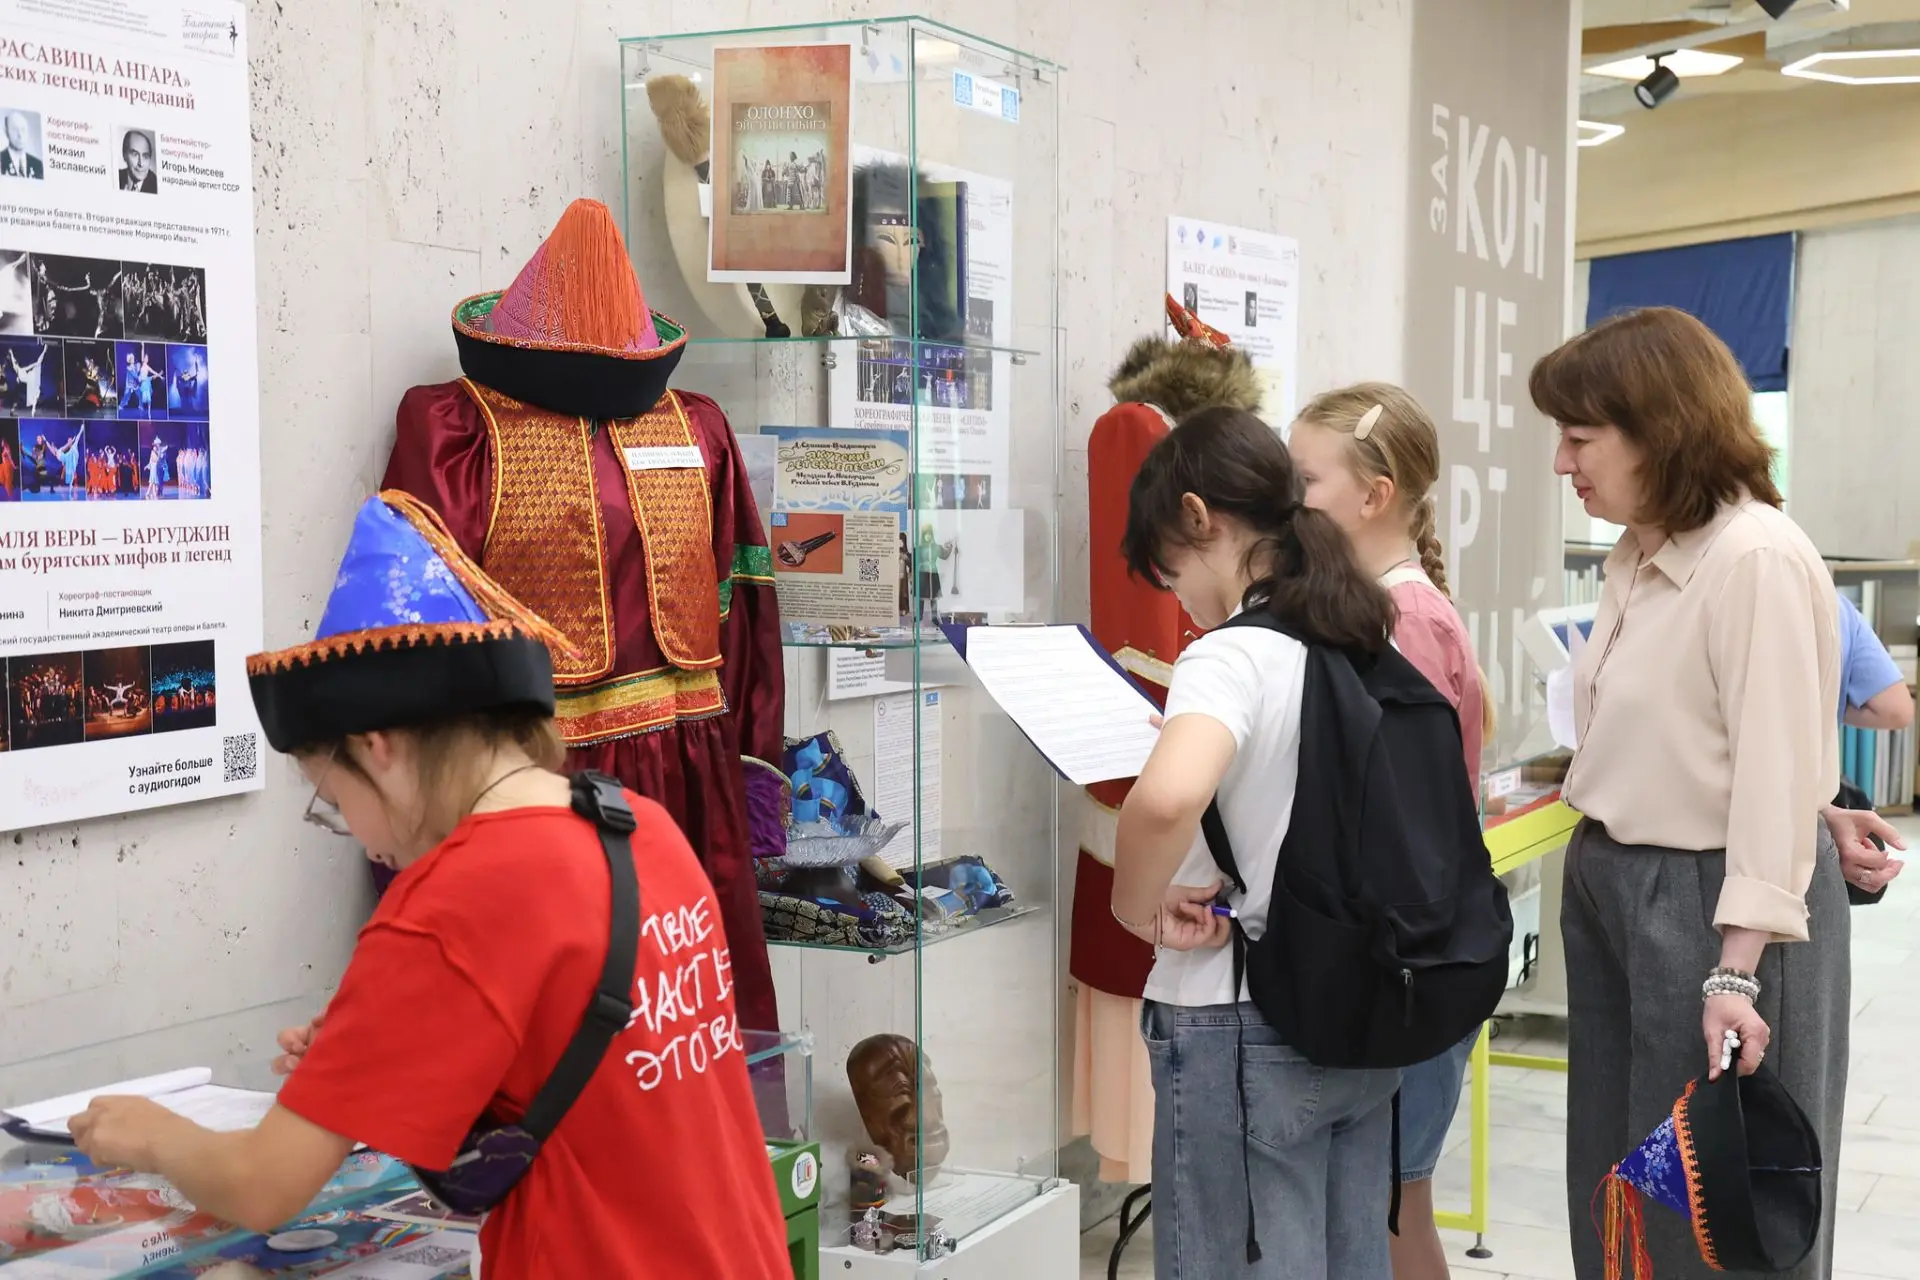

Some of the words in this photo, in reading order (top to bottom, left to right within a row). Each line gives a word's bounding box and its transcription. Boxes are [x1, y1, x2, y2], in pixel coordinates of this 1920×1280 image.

[113, 59, 191, 88] АНГАРА»
[42, 72, 99, 95] легенд
[104, 84, 113, 96] и
[119, 85, 195, 111] преданий
[48, 144, 85, 158] Михаил
[49, 158, 106, 175] Заславский
[162, 160, 188, 174] Игорь
[188, 164, 224, 178] Моисеев
[1430, 103, 1449, 235] ЗАЛ
[162, 176, 197, 187] народный
[198, 180, 220, 190] артист
[221, 182, 240, 192] СССР
[1456, 114, 1548, 281] КОН
[18, 205, 45, 217] оперы
[86, 212, 114, 224] Вторая
[115, 217, 152, 228] редакция
[52, 219, 81, 232] балета
[44, 529, 97, 547] ВЕРЫ
[122, 525, 230, 546] БАРГУДЖИН
[22, 551, 110, 574] бурятских
[114, 547, 167, 569] мифов
[172, 552, 180, 563] и
[184, 549, 232, 564] легенд
[60, 607, 94, 619] Никита
[95, 601, 163, 617] Дмитриевский
[20, 630, 91, 646] государственный
[92, 625, 150, 640] академический
[152, 625, 172, 635] театр
[173, 623, 195, 633] оперы
[128, 762, 173, 778] Узнайте
[175, 757, 213, 771] больше
[129, 784, 135, 793] с
[138, 775, 201, 795] аудиогидом
[641, 896, 714, 955] ТВОЕ
